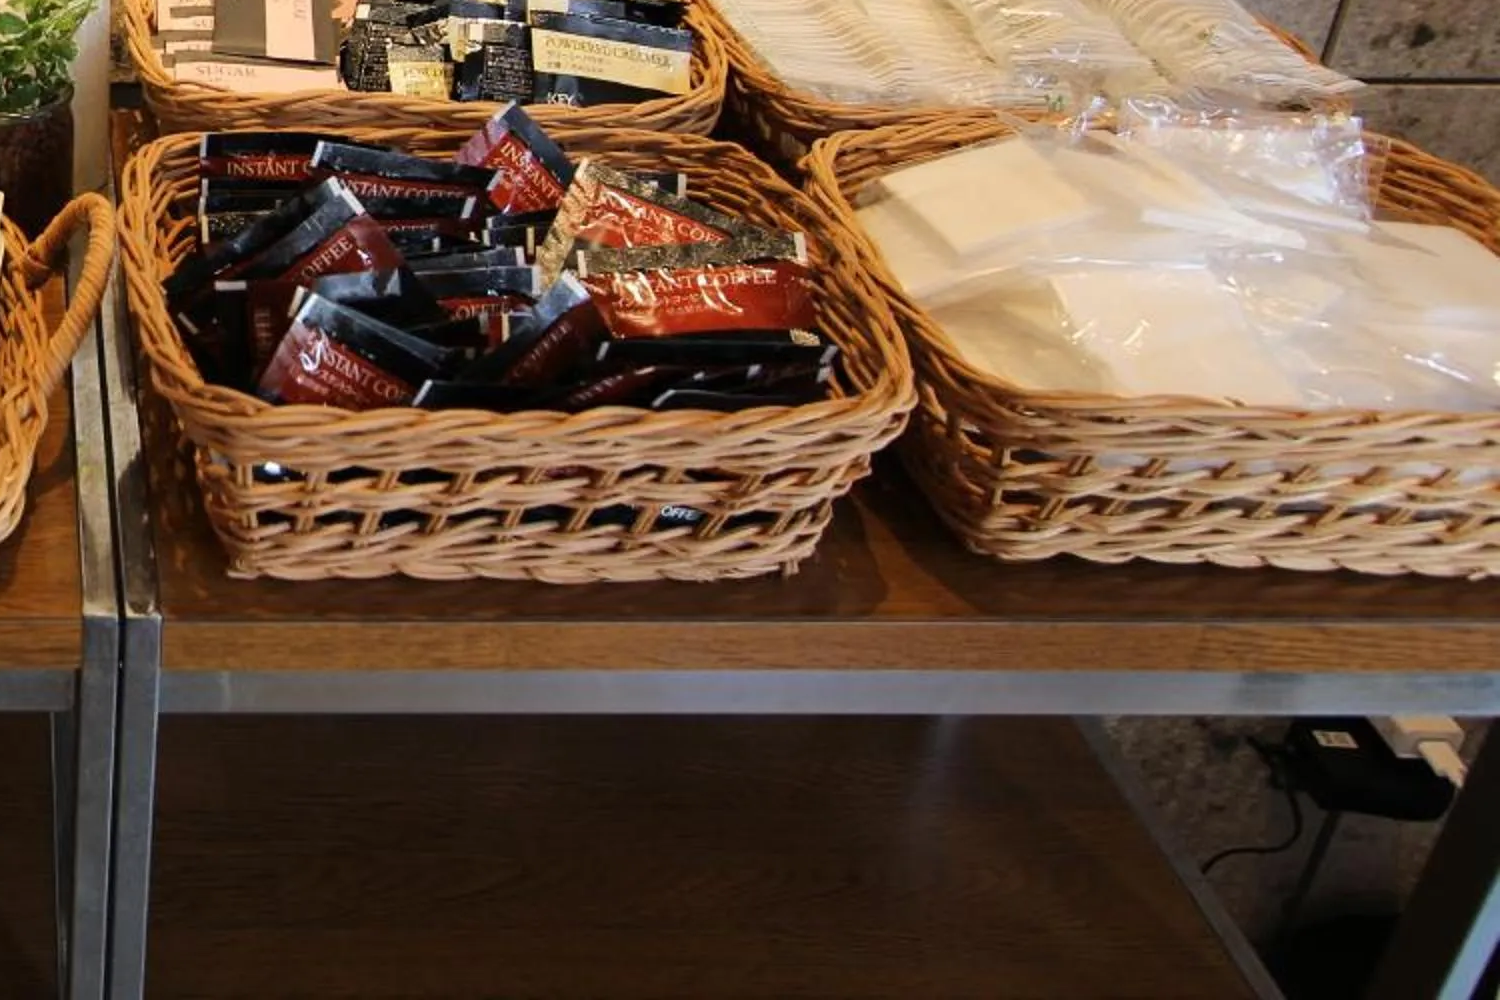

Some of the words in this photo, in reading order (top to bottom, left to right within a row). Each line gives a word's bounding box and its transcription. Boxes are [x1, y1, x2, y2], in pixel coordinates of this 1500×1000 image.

[195, 65, 257, 78] SUGAR
[227, 158, 296, 177] INSTANT
[341, 178, 406, 199] STANT
[301, 235, 353, 280] OFFEE
